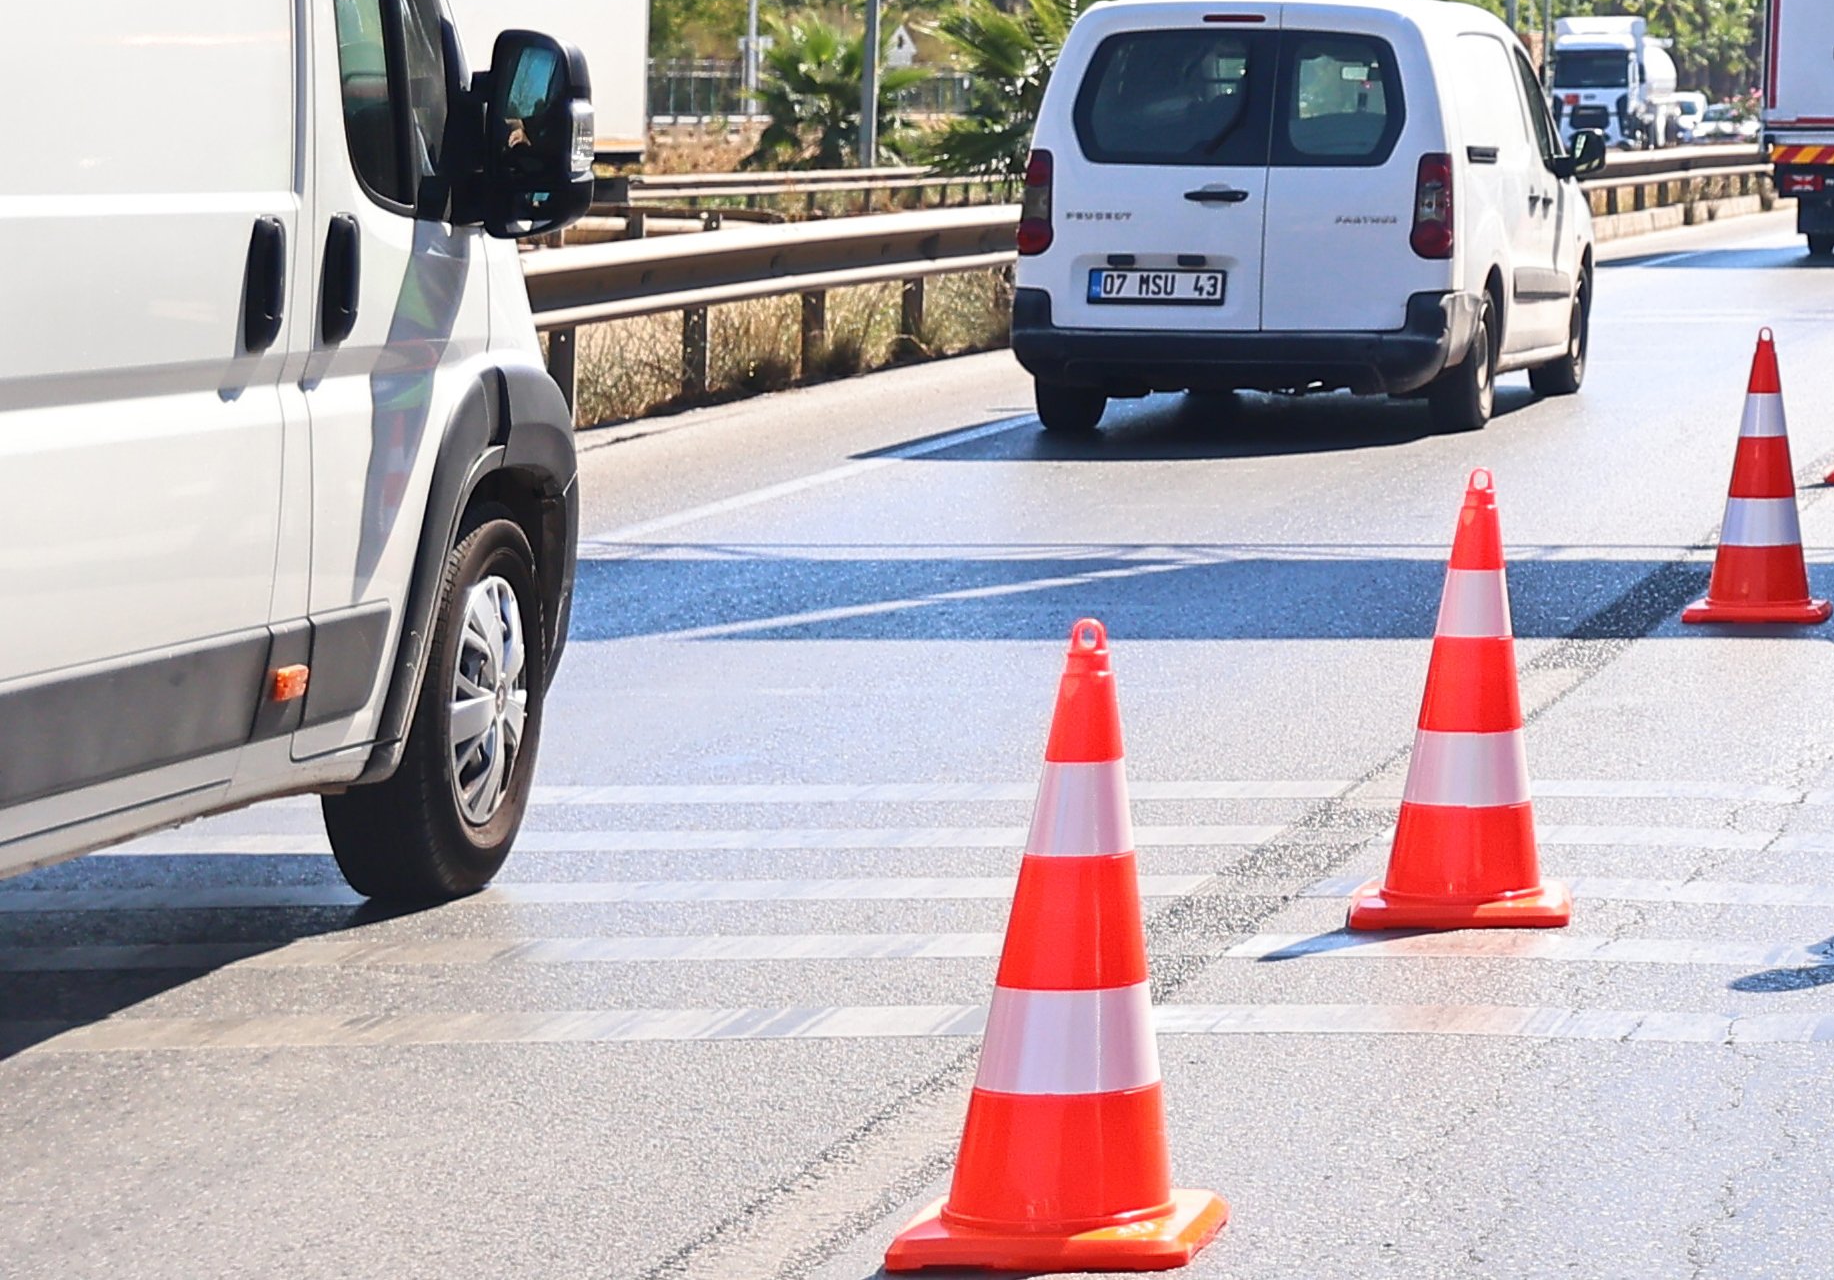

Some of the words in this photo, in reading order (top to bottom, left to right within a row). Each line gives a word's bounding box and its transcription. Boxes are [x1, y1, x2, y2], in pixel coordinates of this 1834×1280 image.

[1102, 275, 1127, 296] 07
[1138, 275, 1176, 296] MSU
[1192, 275, 1218, 297] 43
